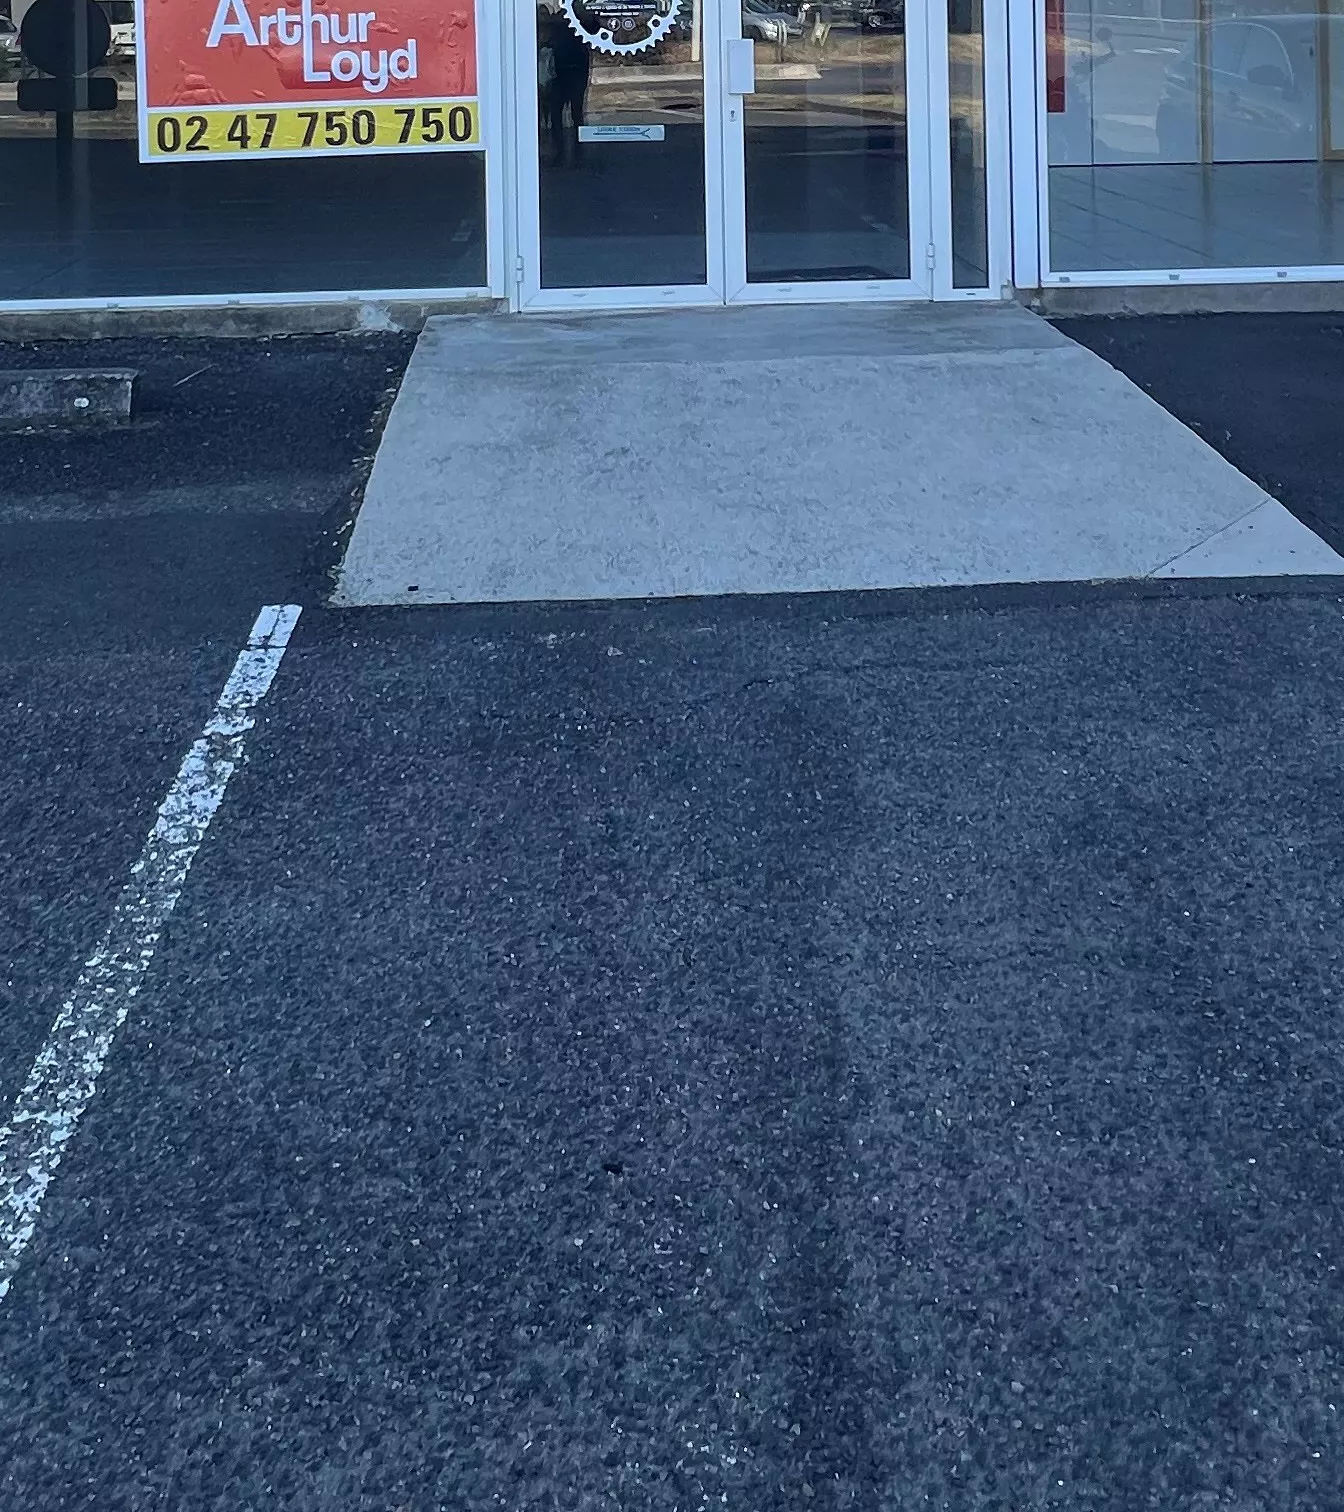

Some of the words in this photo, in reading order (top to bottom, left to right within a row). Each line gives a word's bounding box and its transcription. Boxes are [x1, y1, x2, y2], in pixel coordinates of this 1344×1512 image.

[302, 39, 418, 93] Loyd
[156, 116, 210, 153] 02
[227, 113, 278, 149] 47
[297, 109, 376, 148] 750
[394, 106, 473, 146] 750
